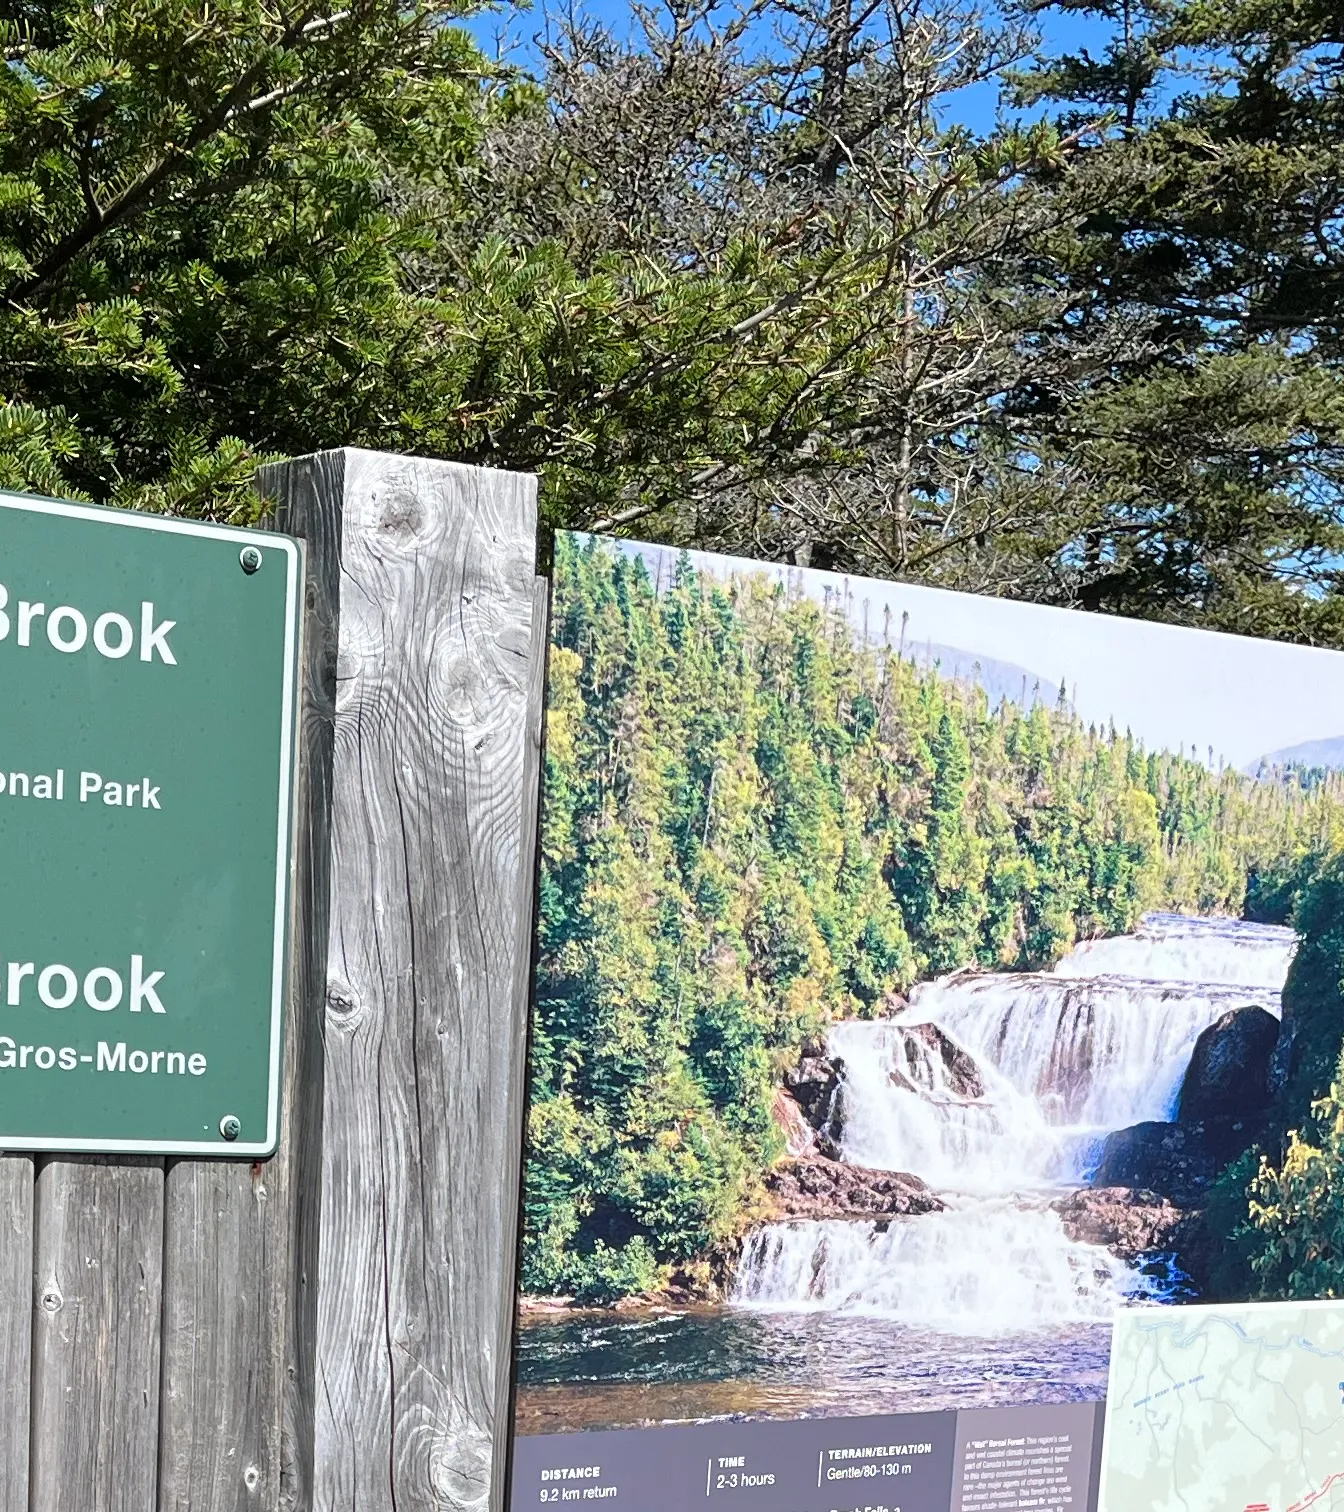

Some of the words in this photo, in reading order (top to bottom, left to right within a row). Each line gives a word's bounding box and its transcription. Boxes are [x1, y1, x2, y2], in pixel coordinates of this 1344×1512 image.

[79, 770, 162, 810] Park
[828, 1443, 932, 1460] TERRAIN/ELEVATION
[718, 1456, 745, 1468] TIME
[541, 1466, 600, 1481] DISTANCE
[827, 1463, 899, 1480] Gentle/80-130
[901, 1465, 912, 1474] m
[716, 1473, 738, 1489] 2-3
[741, 1473, 775, 1487] hours
[540, 1488, 559, 1502] 9.2
[562, 1487, 580, 1500] km
[583, 1486, 617, 1499] return
